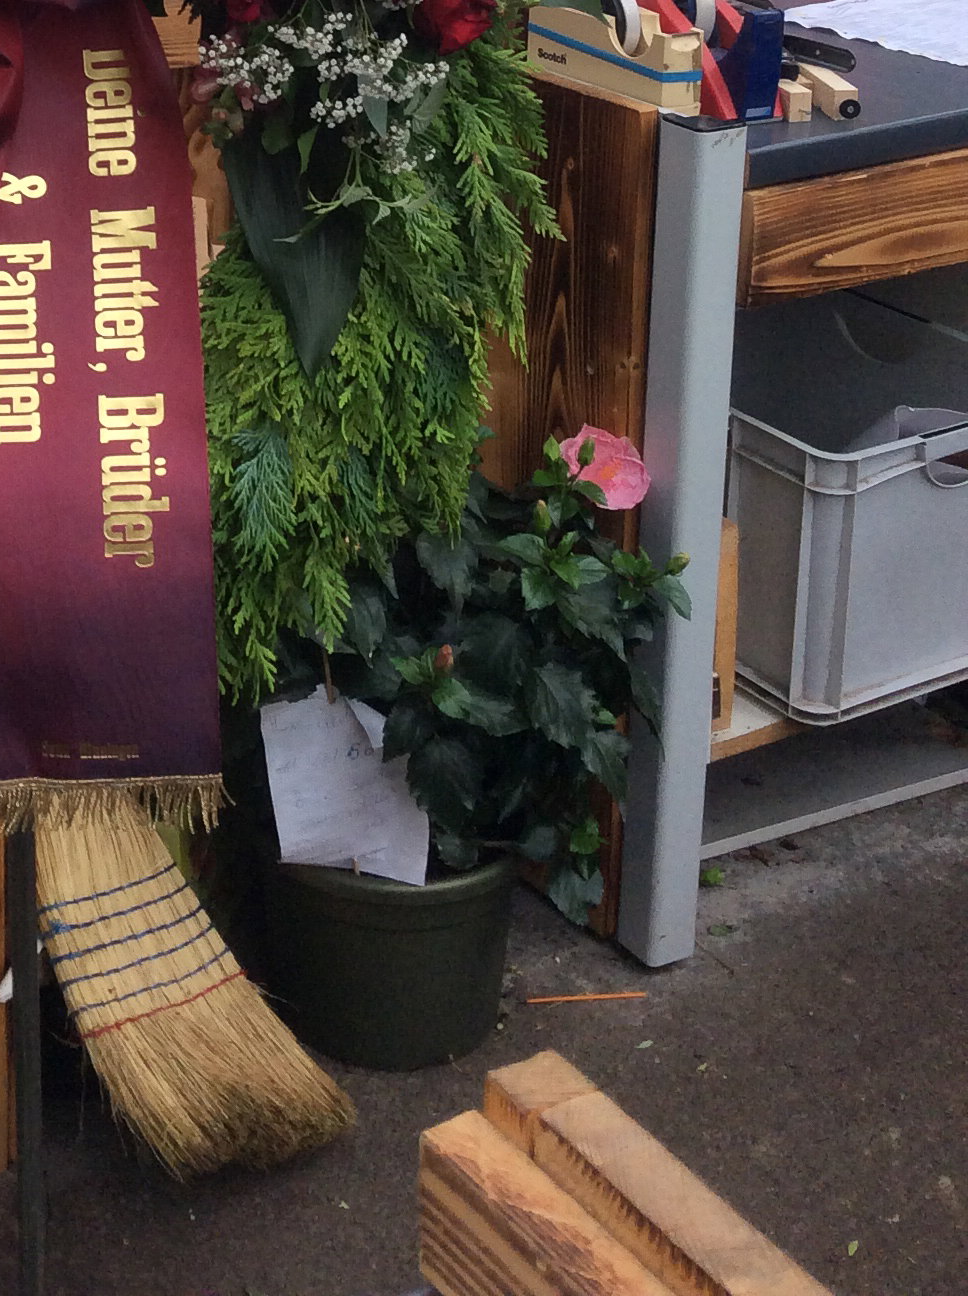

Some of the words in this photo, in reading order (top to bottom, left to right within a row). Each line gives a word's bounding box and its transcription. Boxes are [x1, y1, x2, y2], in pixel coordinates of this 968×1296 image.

[82, 48, 146, 177] Deine
[537, 47, 567, 65] Scotch
[86, 205, 160, 373] Mutter,
[97, 392, 170, 569] Brüder
